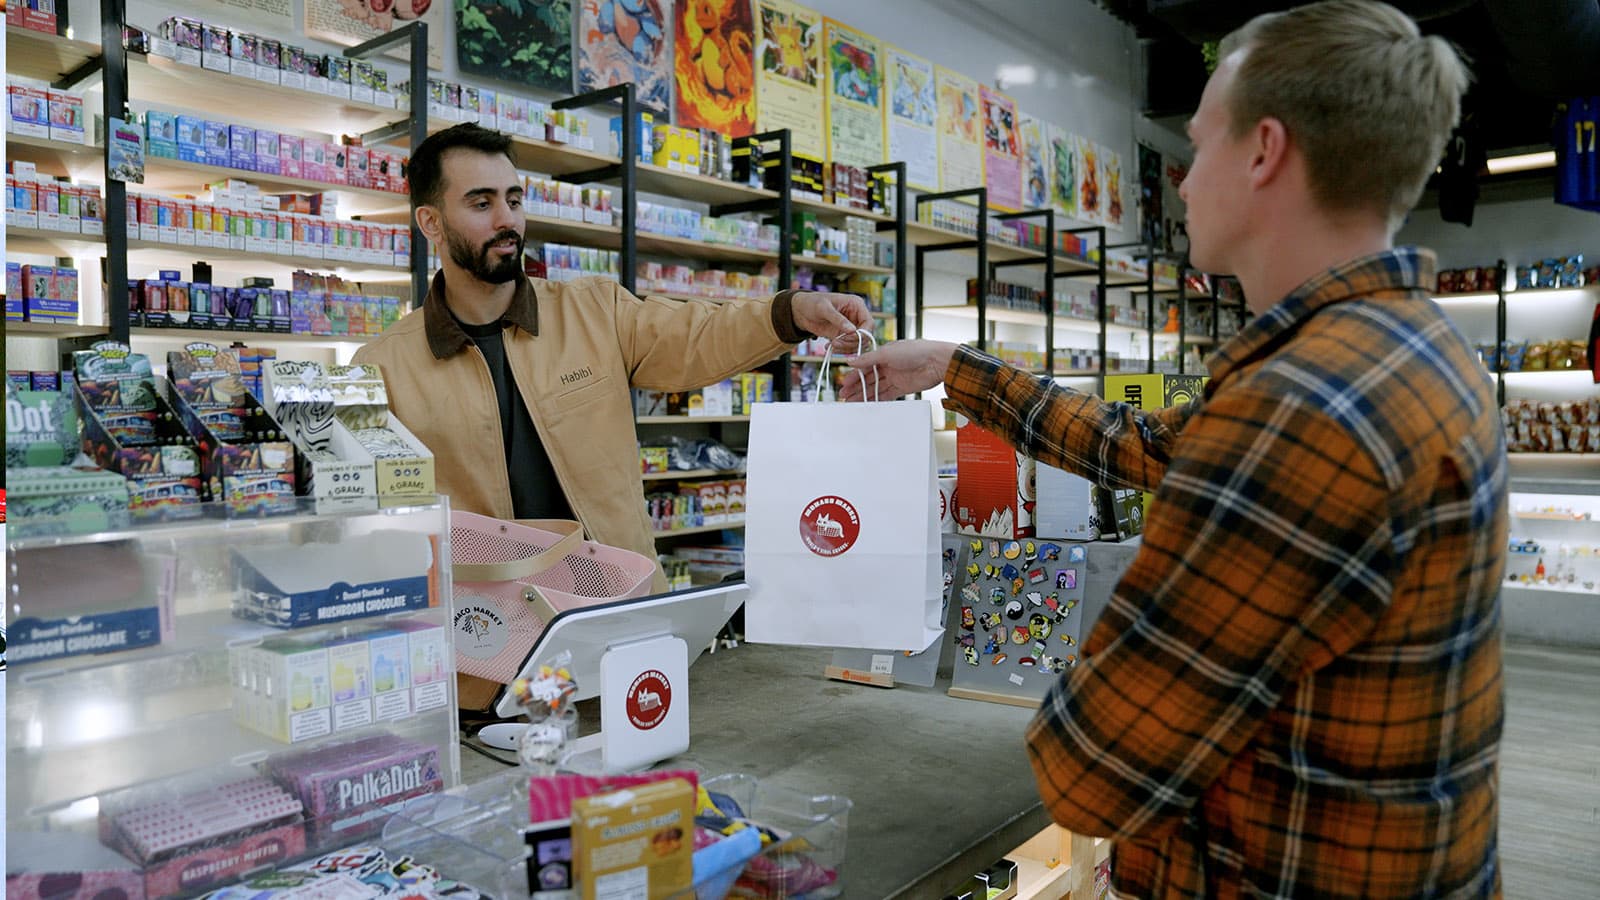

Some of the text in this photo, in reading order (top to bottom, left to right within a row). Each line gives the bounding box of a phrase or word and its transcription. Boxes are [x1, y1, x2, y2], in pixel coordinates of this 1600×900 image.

[1575, 121, 1596, 154] 17
[560, 366, 592, 384] Habibi
[335, 486, 364, 495] GRAMS
[396, 481, 424, 490] GRAMS
[317, 595, 406, 620] MUSHROOM CHOCOLATE
[474, 606, 503, 626] MARKET
[67, 630, 126, 651] CHOCOLATE
[182, 843, 279, 881] RASPBERRY MUFFIN
